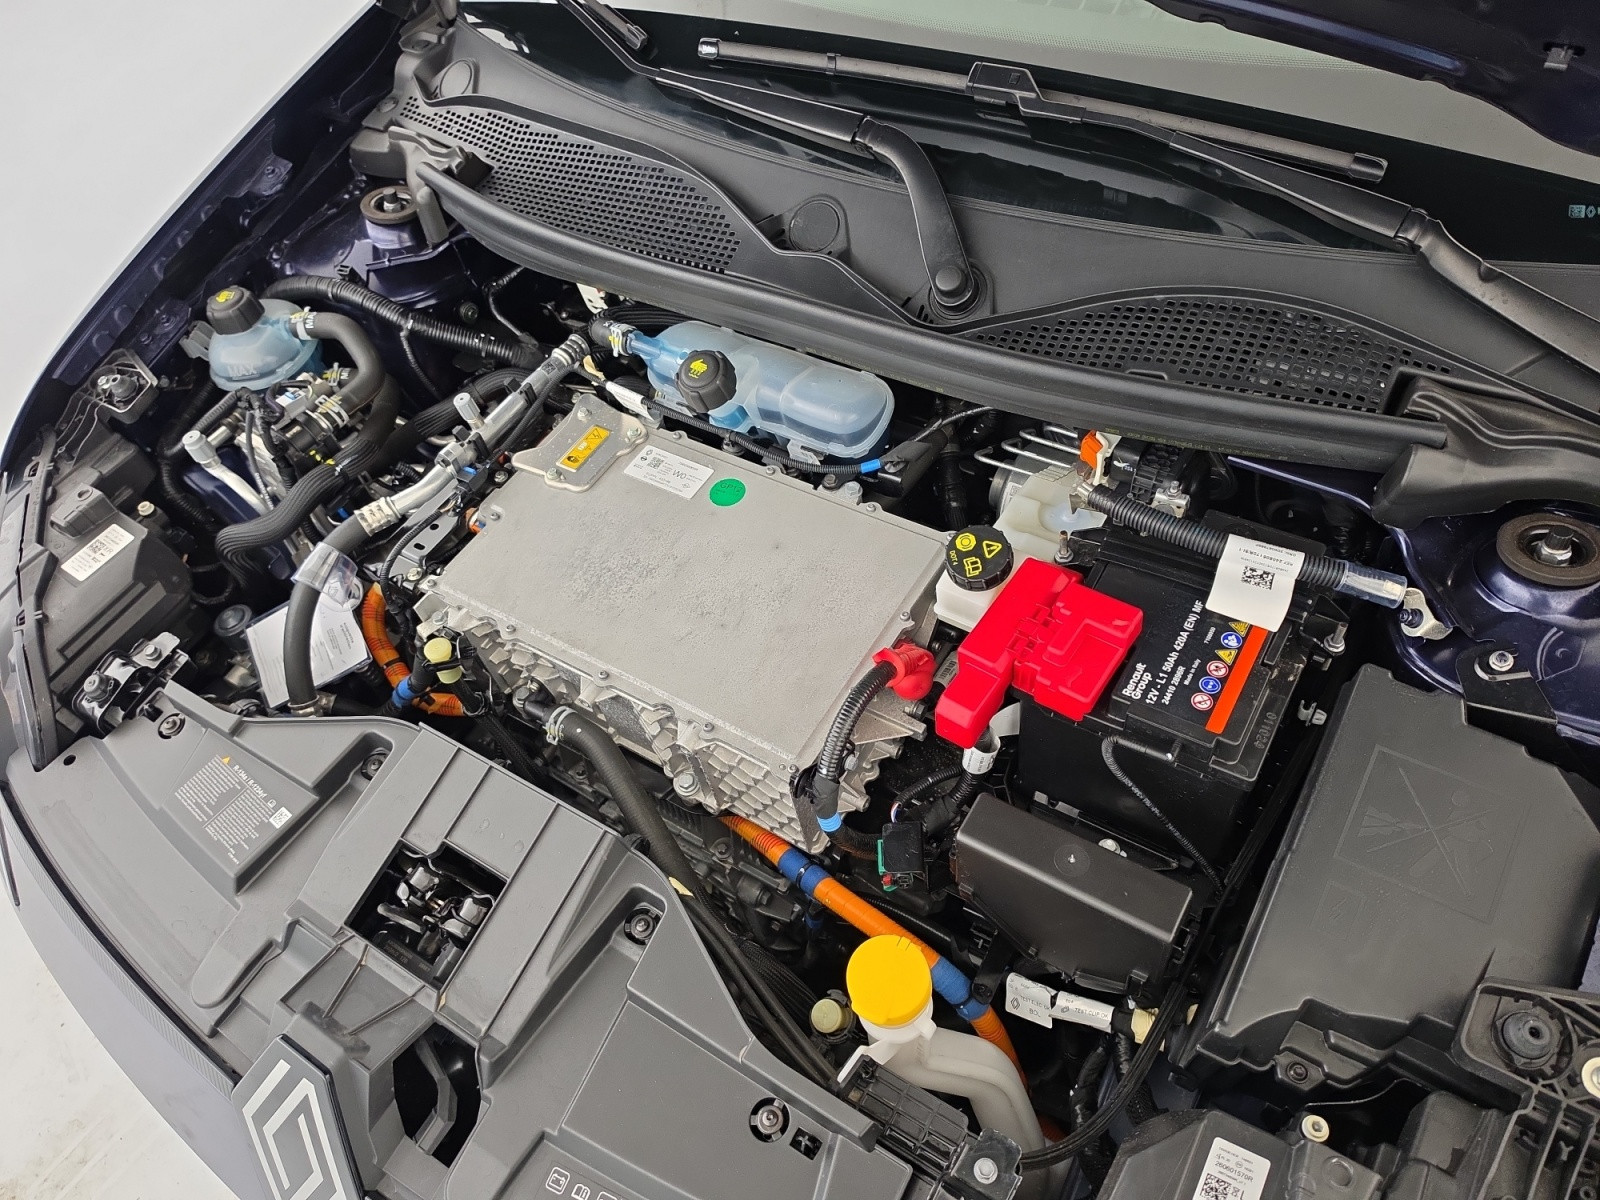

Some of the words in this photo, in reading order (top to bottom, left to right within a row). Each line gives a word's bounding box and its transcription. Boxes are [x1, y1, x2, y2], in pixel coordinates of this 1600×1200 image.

[1191, 599, 1204, 613] MF
[1183, 613, 1200, 631] (EN)
[1173, 631, 1190, 652] 420A
[1162, 651, 1180, 672] 50Ah
[1122, 662, 1147, 697] Renault
[1131, 672, 1152, 699] Group
[1156, 672, 1168, 685] L1
[1145, 688, 1159, 704] 12V
[1074, 1007, 1087, 1016] TEST
